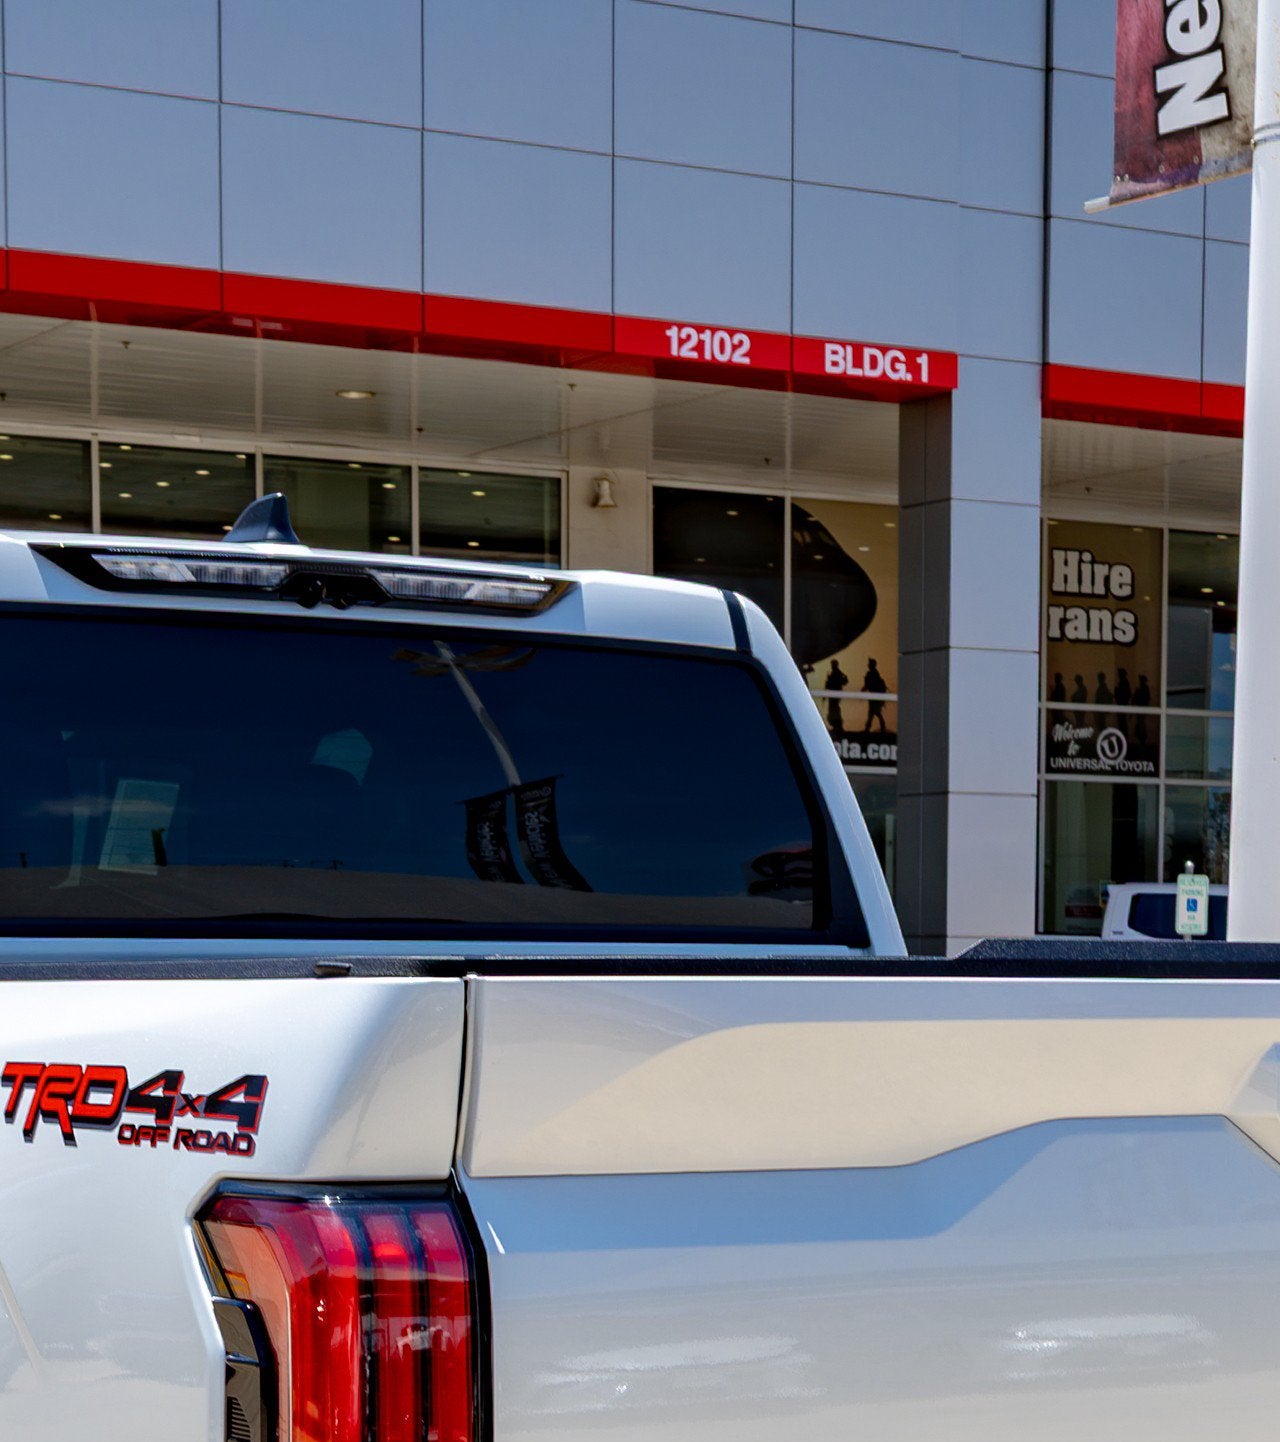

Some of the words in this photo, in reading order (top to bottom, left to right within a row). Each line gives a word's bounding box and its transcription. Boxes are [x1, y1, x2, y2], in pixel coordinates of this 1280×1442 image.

[1155, 0, 1231, 135] Ne
[665, 325, 751, 365] 12102
[1052, 548, 1133, 597] Hire
[1047, 606, 1137, 644] rans
[1050, 757, 1112, 771] UNIVERSAL
[1114, 760, 1155, 773] TOYOTA
[0, 1061, 129, 1148] TRD
[117, 1123, 171, 1149] OFF
[173, 1127, 256, 1158] ROAD
